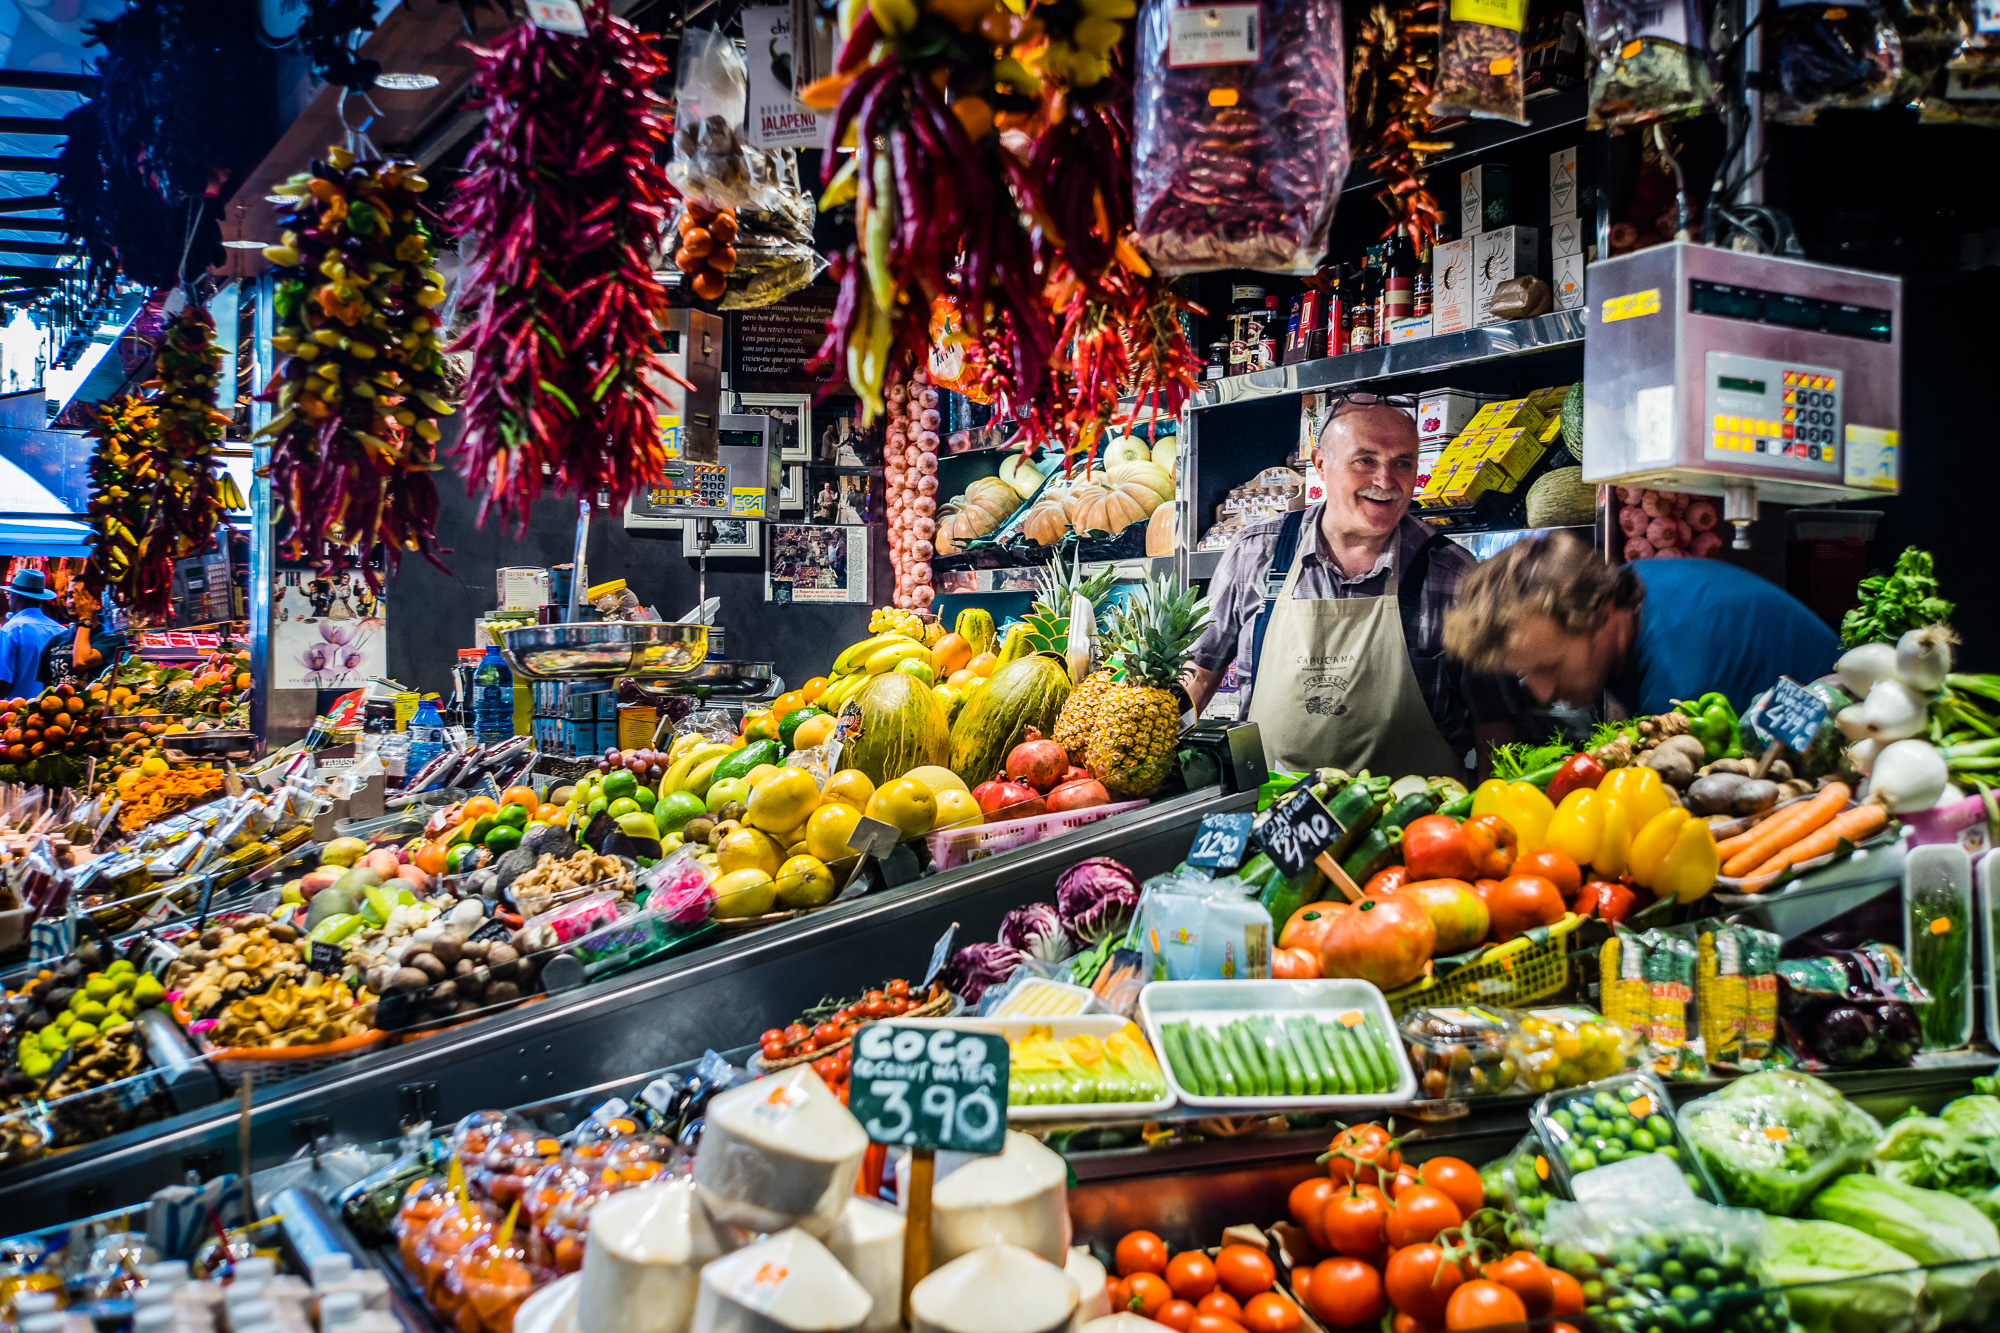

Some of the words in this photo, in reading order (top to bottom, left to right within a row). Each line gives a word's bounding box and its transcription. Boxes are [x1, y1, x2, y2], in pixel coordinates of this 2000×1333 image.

[859, 1025, 988, 1066] COCO
[853, 1057, 930, 1083] COCONUT
[932, 1062, 997, 1086] WATER
